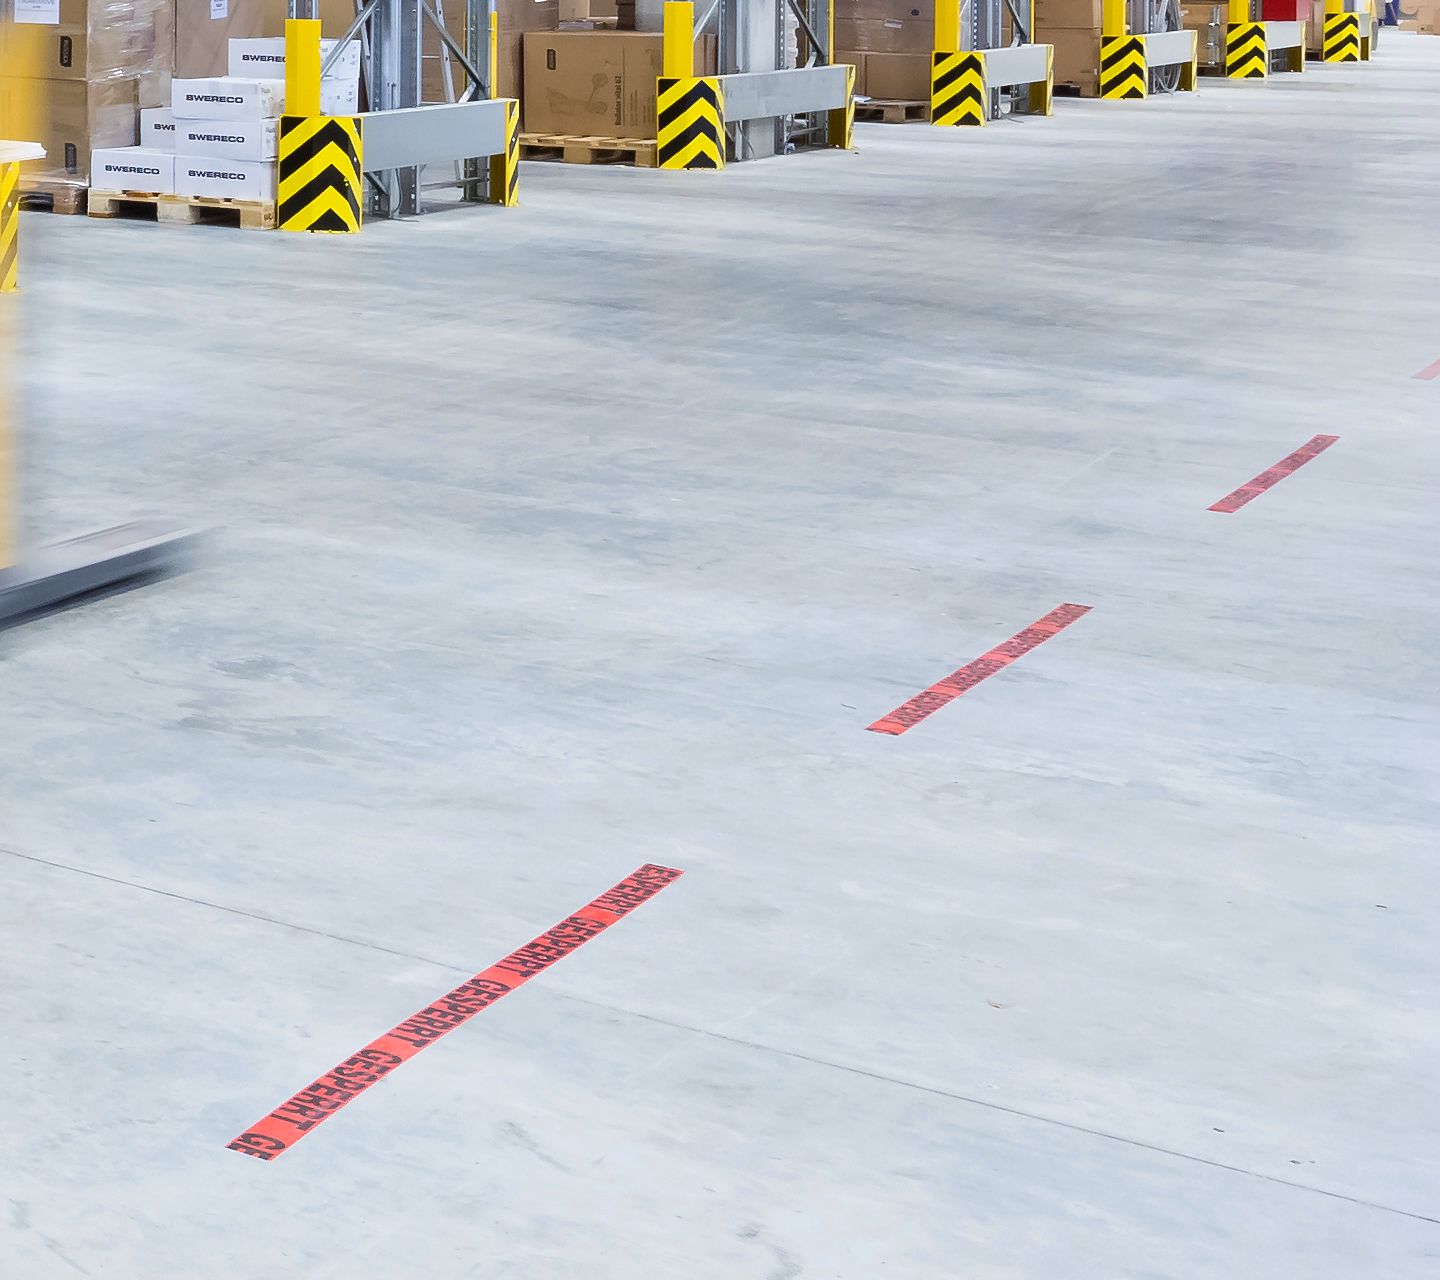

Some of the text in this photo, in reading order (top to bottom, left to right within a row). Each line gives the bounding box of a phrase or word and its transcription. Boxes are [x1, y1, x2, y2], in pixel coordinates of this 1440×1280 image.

[242, 54, 286, 62] BWEREC
[186, 94, 244, 104] BWERECO
[188, 133, 245, 143] BWERECO
[105, 164, 160, 175] BWERECO
[188, 170, 246, 180] BWERECO
[591, 863, 681, 914] ESPERRT
[495, 915, 608, 979] GESPERRT
[380, 978, 511, 1049] GESPERRT
[271, 1049, 402, 1131] GESPERRT
